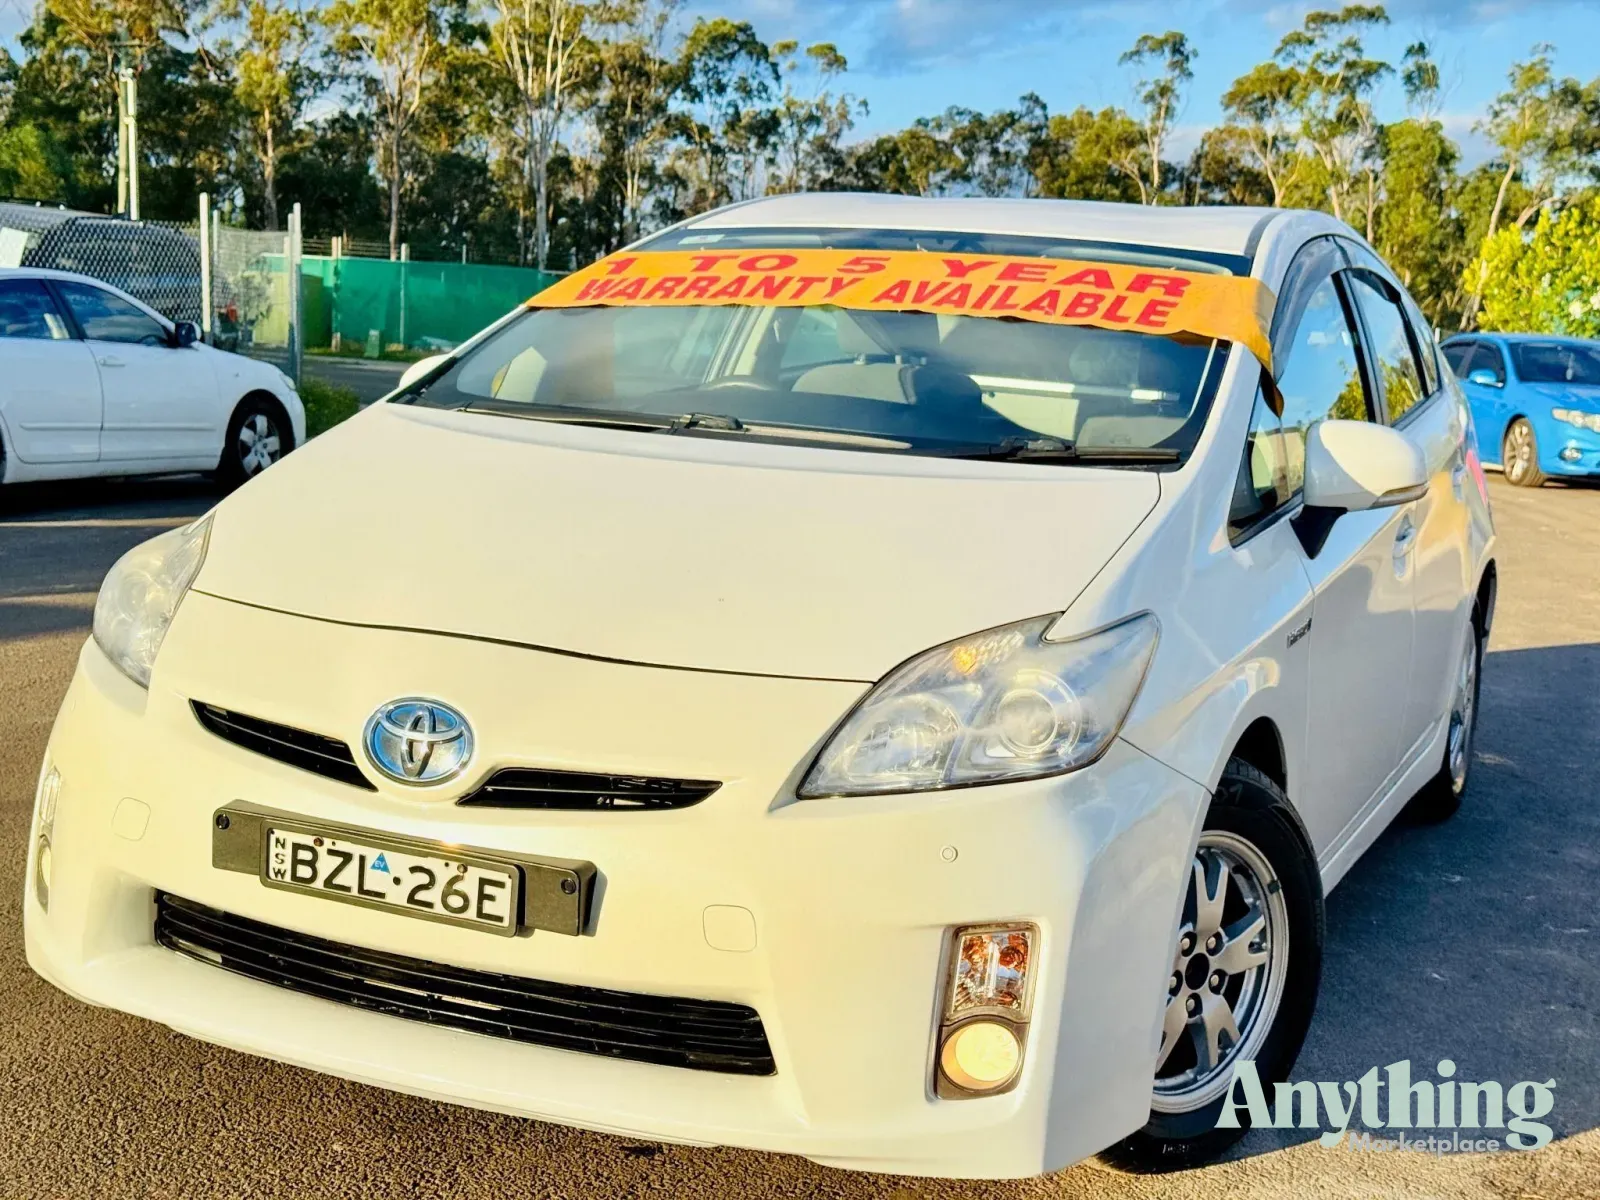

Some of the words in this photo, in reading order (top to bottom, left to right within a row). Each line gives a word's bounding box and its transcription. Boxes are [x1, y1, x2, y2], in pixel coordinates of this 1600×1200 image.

[605, 257, 640, 275] 1
[690, 254, 798, 273] TO
[836, 256, 891, 274] 5
[941, 258, 1192, 298] YEAR
[574, 275, 865, 301] WARRANTY
[870, 279, 1180, 328] AVAILABLE
